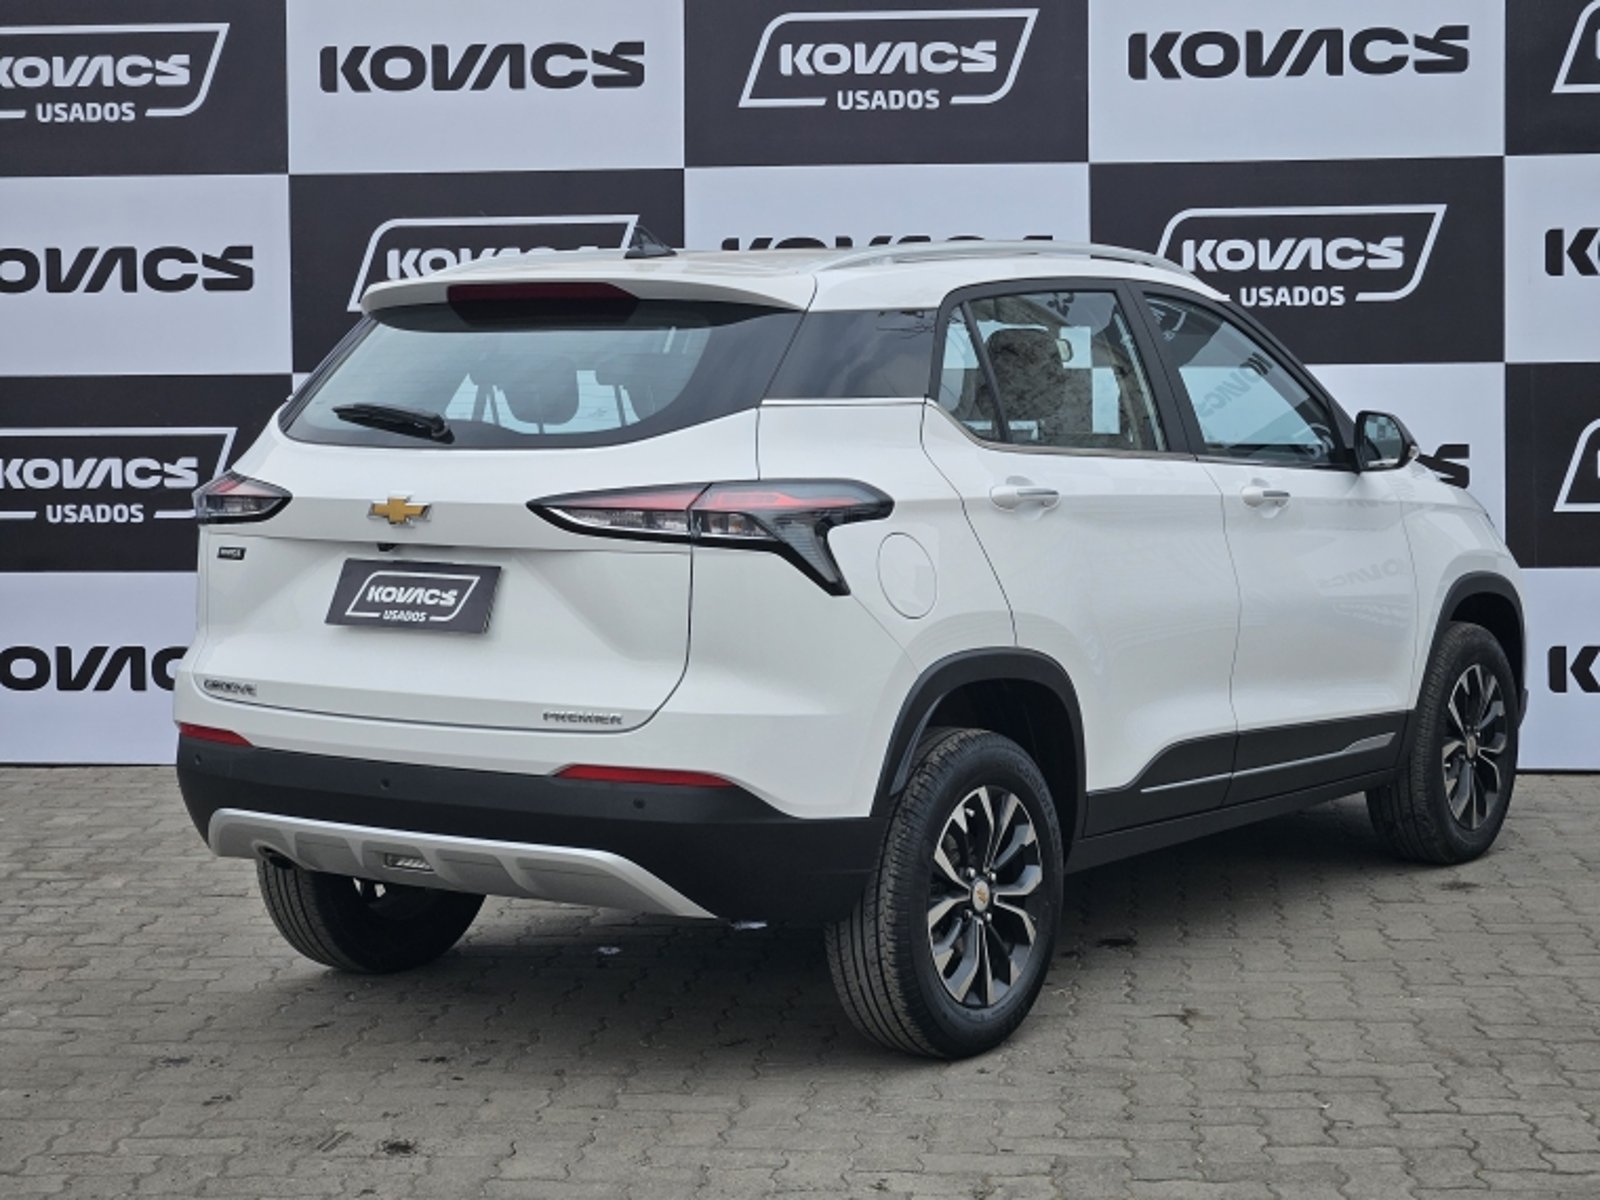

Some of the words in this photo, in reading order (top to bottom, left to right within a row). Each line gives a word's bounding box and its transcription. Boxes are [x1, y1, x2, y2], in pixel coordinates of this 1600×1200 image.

[320, 40, 645, 93] KOVACS
[779, 40, 997, 76] KOVACS
[1128, 24, 1470, 81] KOVACS
[36, 102, 136, 123] USADOS
[836, 89, 940, 111] USADOS
[1181, 236, 1404, 273] KOVACS
[1544, 227, 1600, 276] K
[0, 245, 254, 294] OVACS
[1240, 285, 1346, 307] USADOS
[46, 503, 144, 523] USADOS
[366, 584, 459, 607] KOVACS
[382, 609, 427, 622] USADOS
